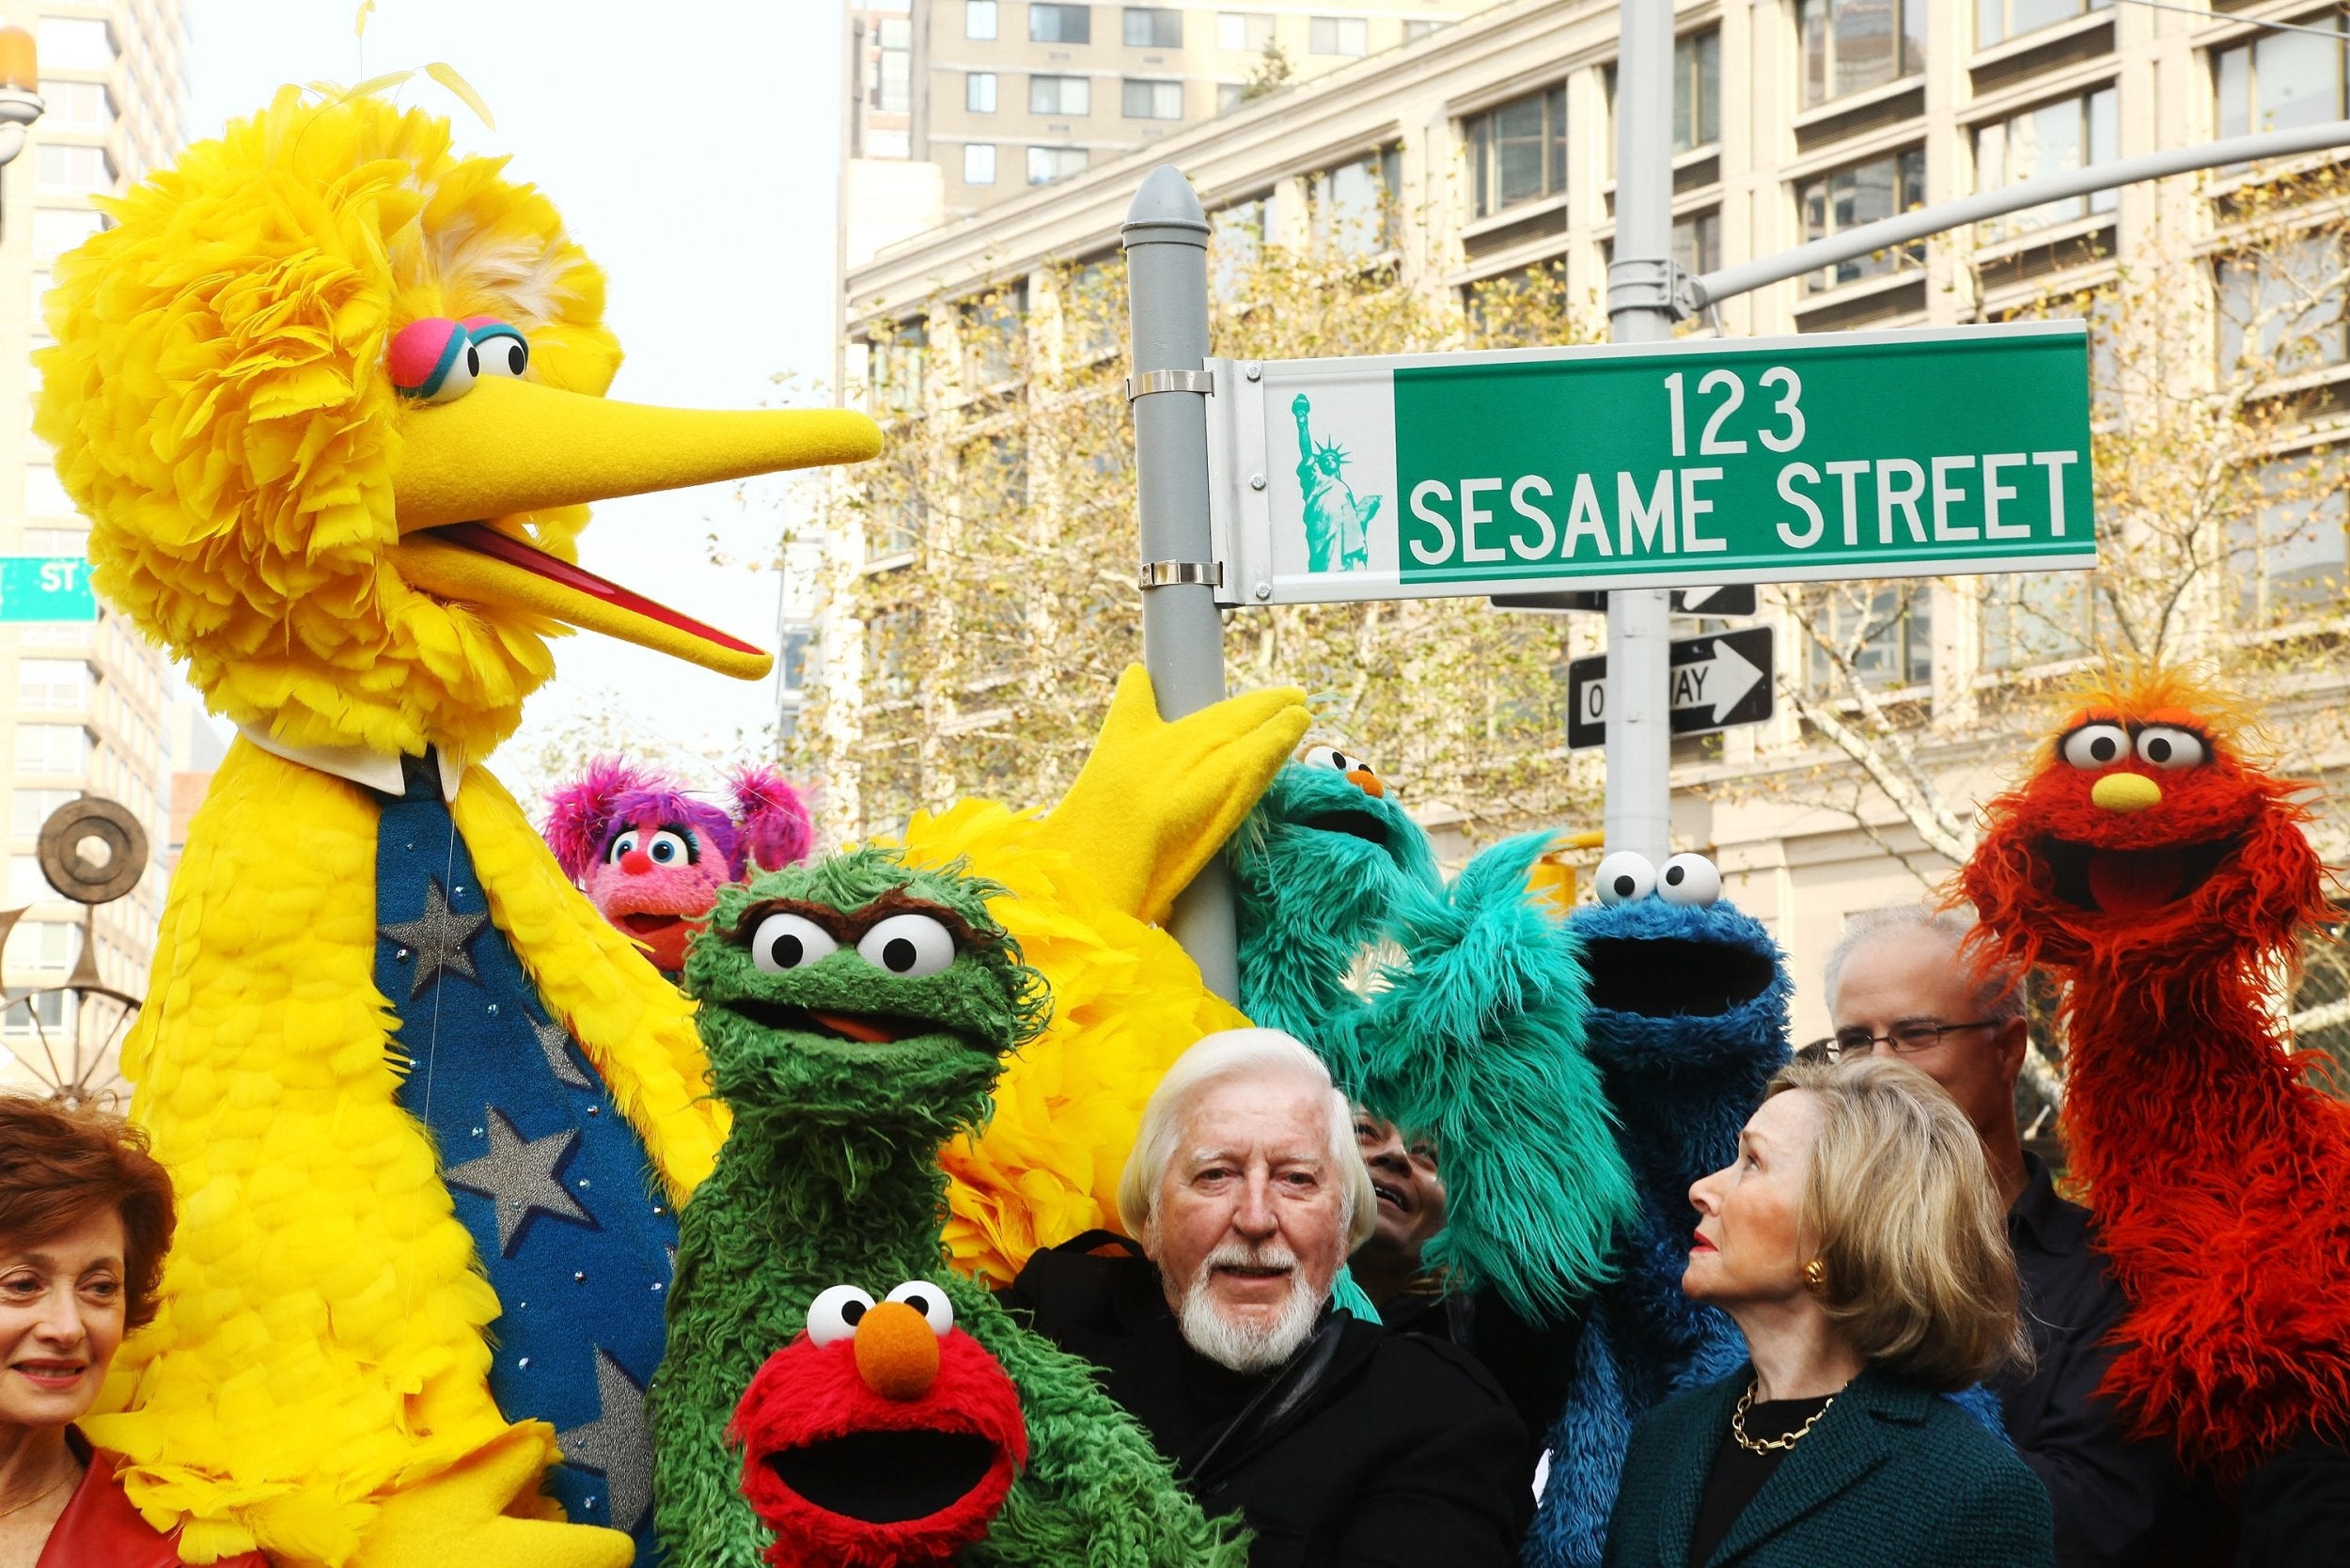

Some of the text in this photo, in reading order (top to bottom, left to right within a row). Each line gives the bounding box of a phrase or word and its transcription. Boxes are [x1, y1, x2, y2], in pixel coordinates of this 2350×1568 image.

[1664, 366, 1806, 457] 123
[1409, 450, 2078, 566] SESAME STREET
[40, 562, 79, 592] ST
[1670, 666, 1708, 705] AY
